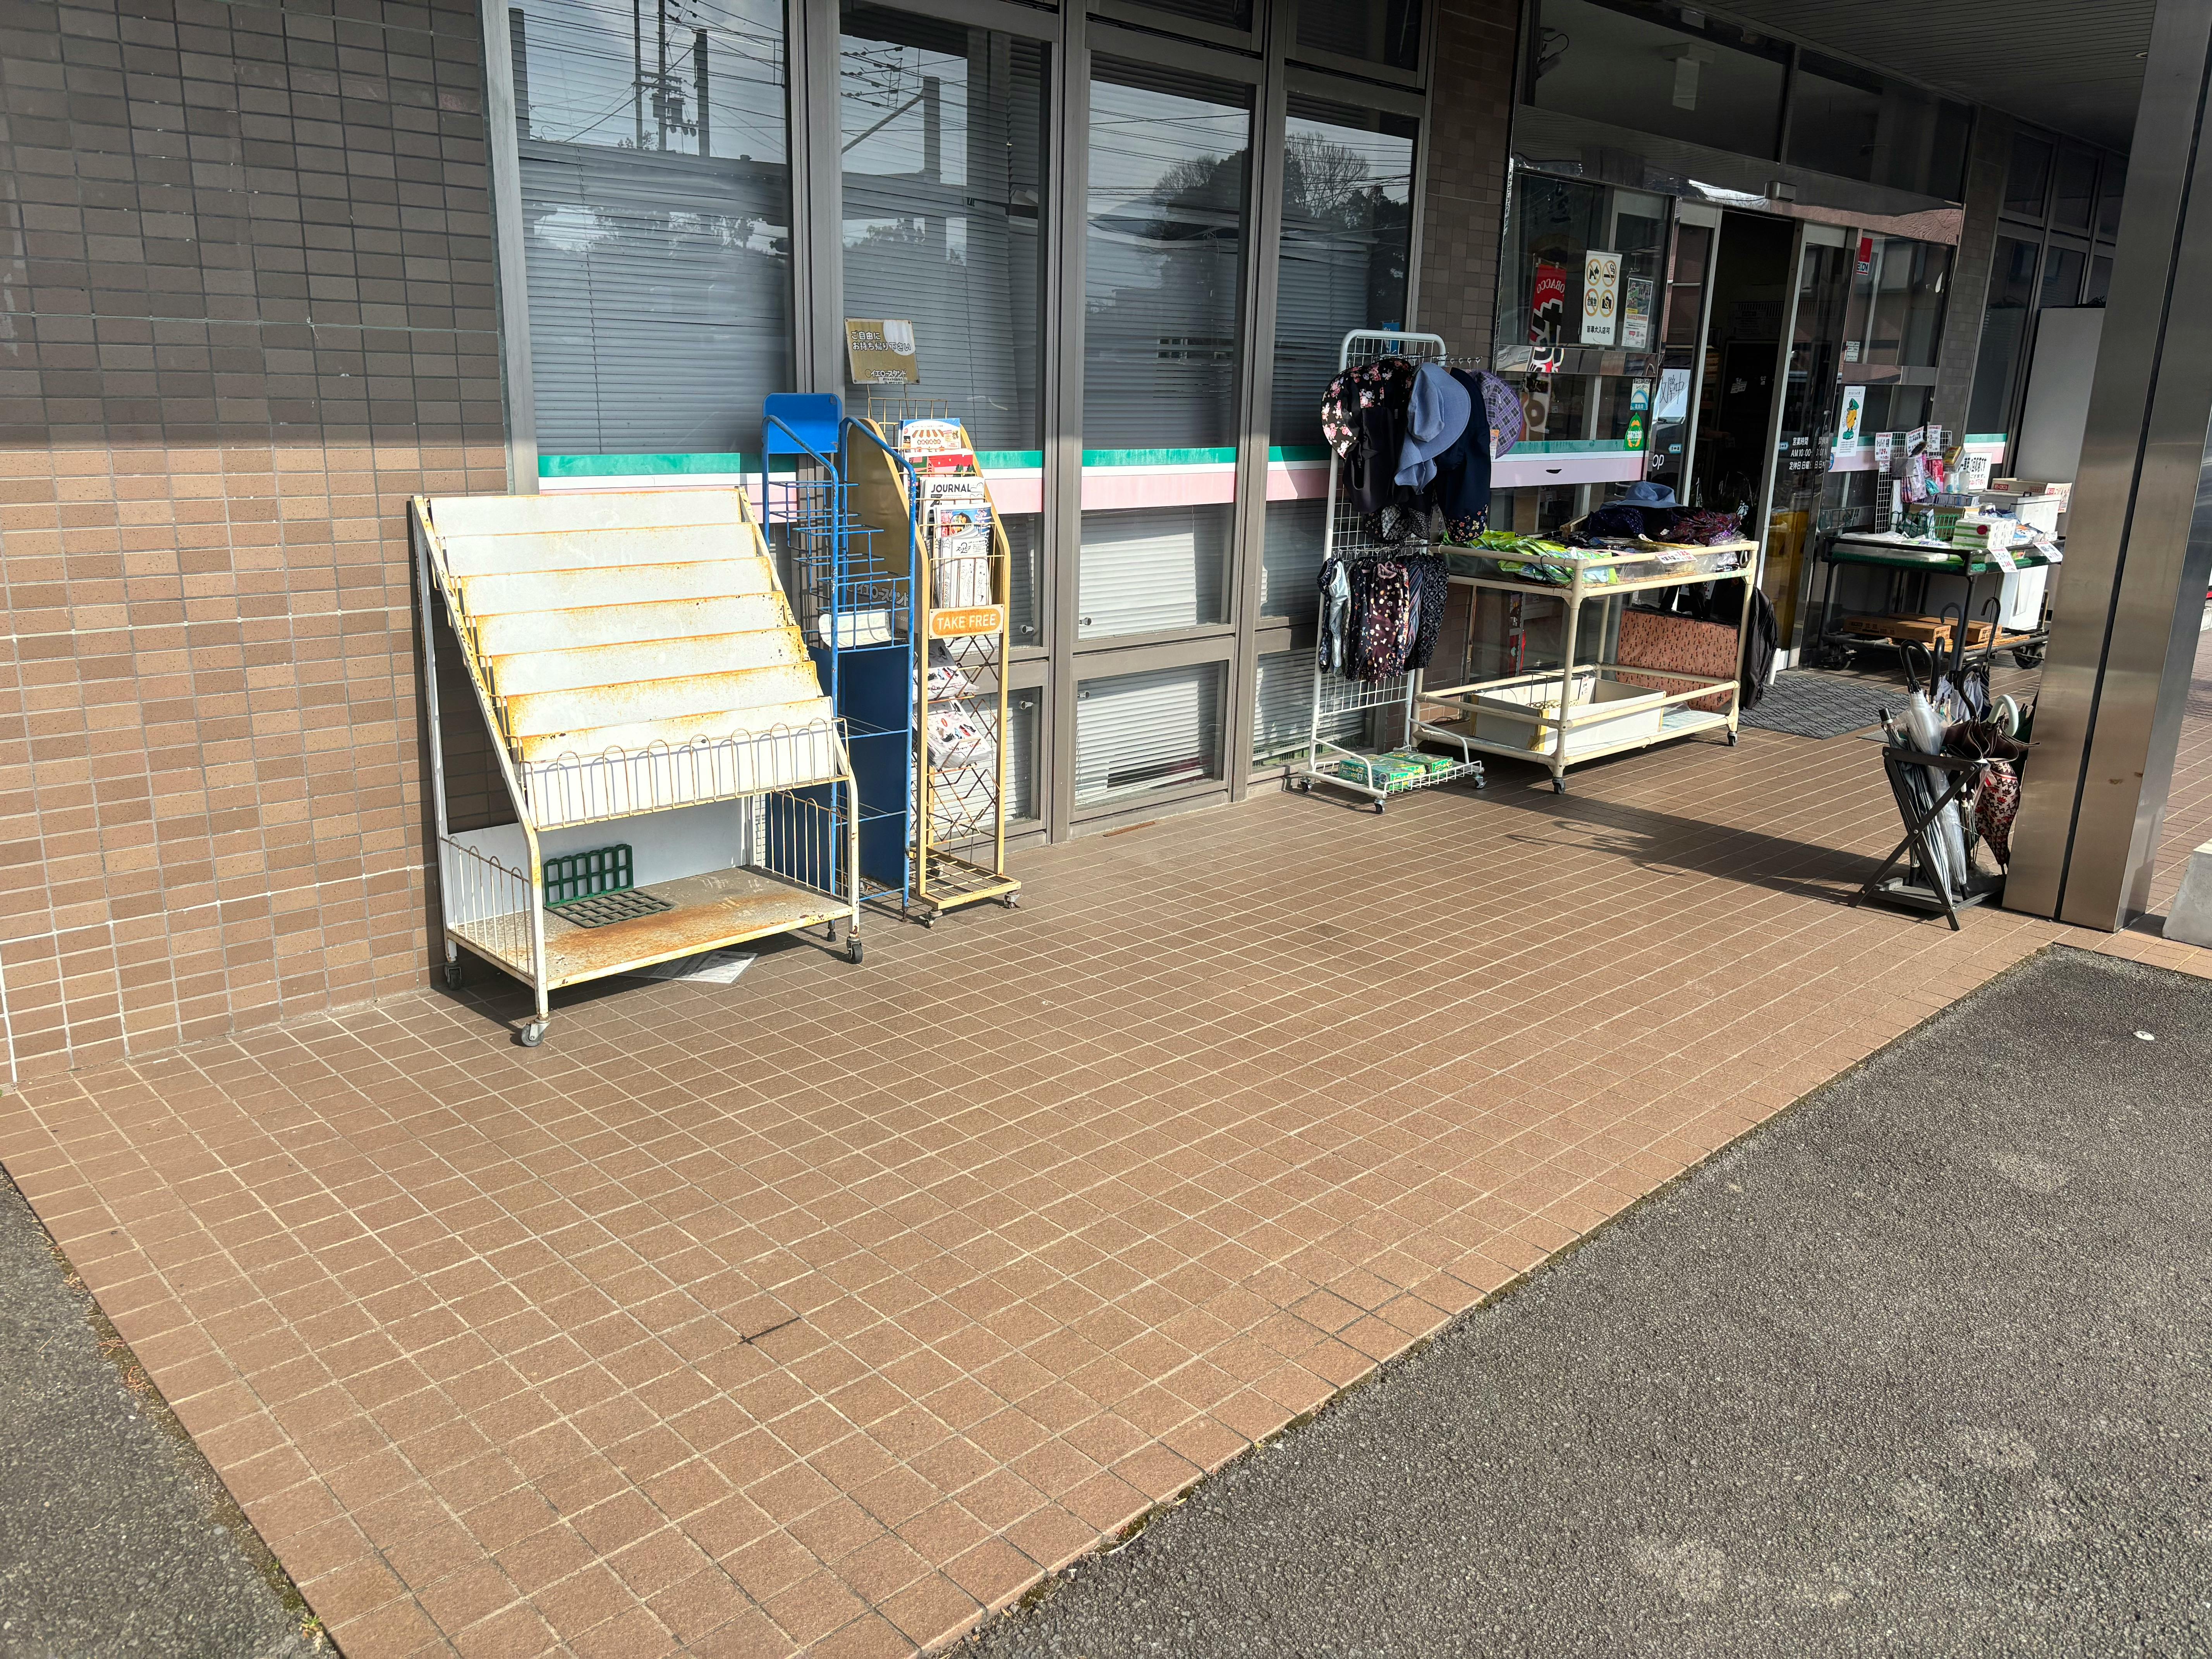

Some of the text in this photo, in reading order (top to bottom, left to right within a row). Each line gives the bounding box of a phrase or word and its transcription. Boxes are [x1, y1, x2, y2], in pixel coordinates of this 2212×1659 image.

[1857, 262, 1868, 271] ECOM
[1587, 326, 1610, 334] 盲導犬入店可
[851, 330, 881, 340] ご自由に
[852, 341, 911, 352] お持ち帰り下さい
[870, 369, 907, 378] イエロースタンド
[1792, 437, 1809, 446] 営業時間
[931, 484, 971, 493] JOURNAL
[937, 613, 997, 630] TAKE FREE
